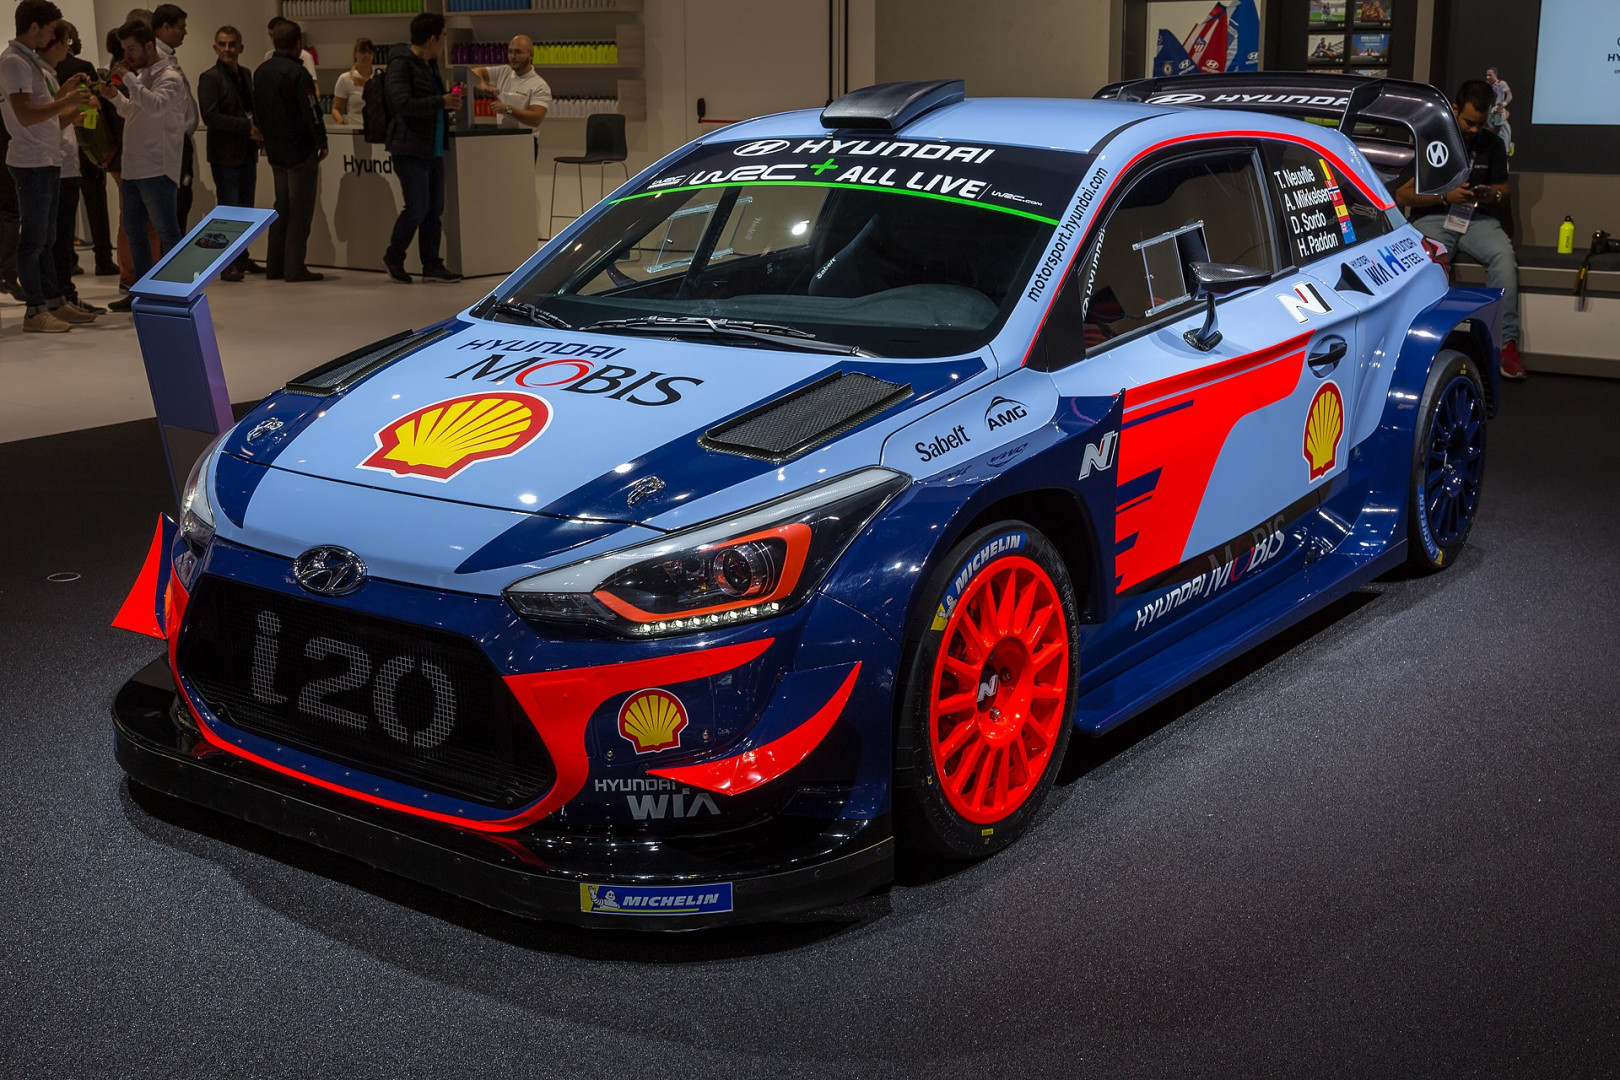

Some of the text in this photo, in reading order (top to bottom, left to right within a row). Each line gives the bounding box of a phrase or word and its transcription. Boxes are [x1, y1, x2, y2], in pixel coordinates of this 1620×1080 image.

[792, 139, 996, 164] HYUNDAI
[835, 165, 897, 186] ALL
[905, 171, 987, 199] LIVE
[1273, 165, 1316, 189] T. Neuville
[1283, 186, 1333, 212] A. Mikkelsen
[1027, 166, 1108, 302] motorsport.hyundai.com
[1290, 209, 1327, 234] D. Sordo
[1296, 231, 1339, 257] H. Paddon
[1400, 251, 1424, 269] STEEL
[456, 339, 627, 359] HYUNDAI
[444, 354, 705, 407] MOBIS
[987, 404, 1028, 432] AMG
[914, 424, 971, 463] Sabelt
[955, 534, 1021, 594] MICHELIN
[1135, 573, 1206, 632] HYUNDAI
[251, 610, 457, 750] i20
[595, 778, 676, 792] HYUNDAI
[622, 893, 719, 907] MICHELIN
